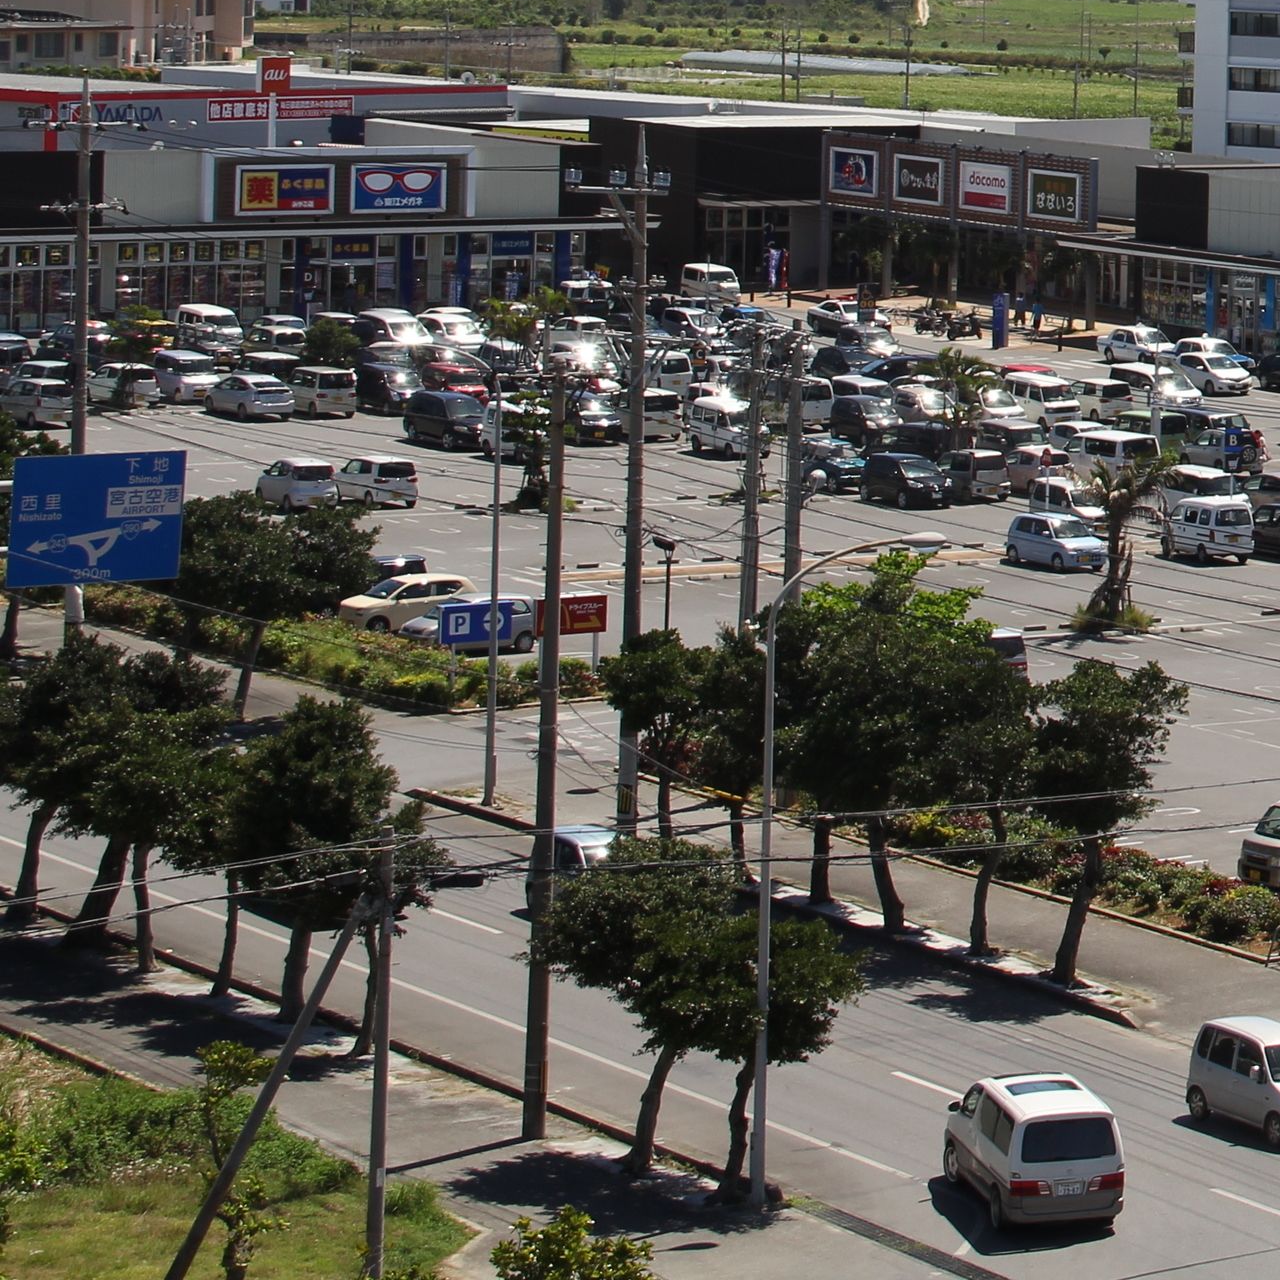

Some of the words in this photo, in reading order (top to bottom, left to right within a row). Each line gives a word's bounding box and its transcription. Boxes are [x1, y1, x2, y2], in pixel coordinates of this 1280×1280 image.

[264, 67, 288, 81] au
[969, 171, 1006, 188] docomo
[1036, 192, 1075, 212] なないろ
[1229, 434, 1239, 446] B
[125, 456, 169, 473] 下地
[128, 475, 163, 484] Shimoji
[20, 494, 61, 511] 西里
[110, 488, 180, 506] 宮古空港
[121, 504, 166, 515] AIRPORT
[455, 616, 466, 632] P
